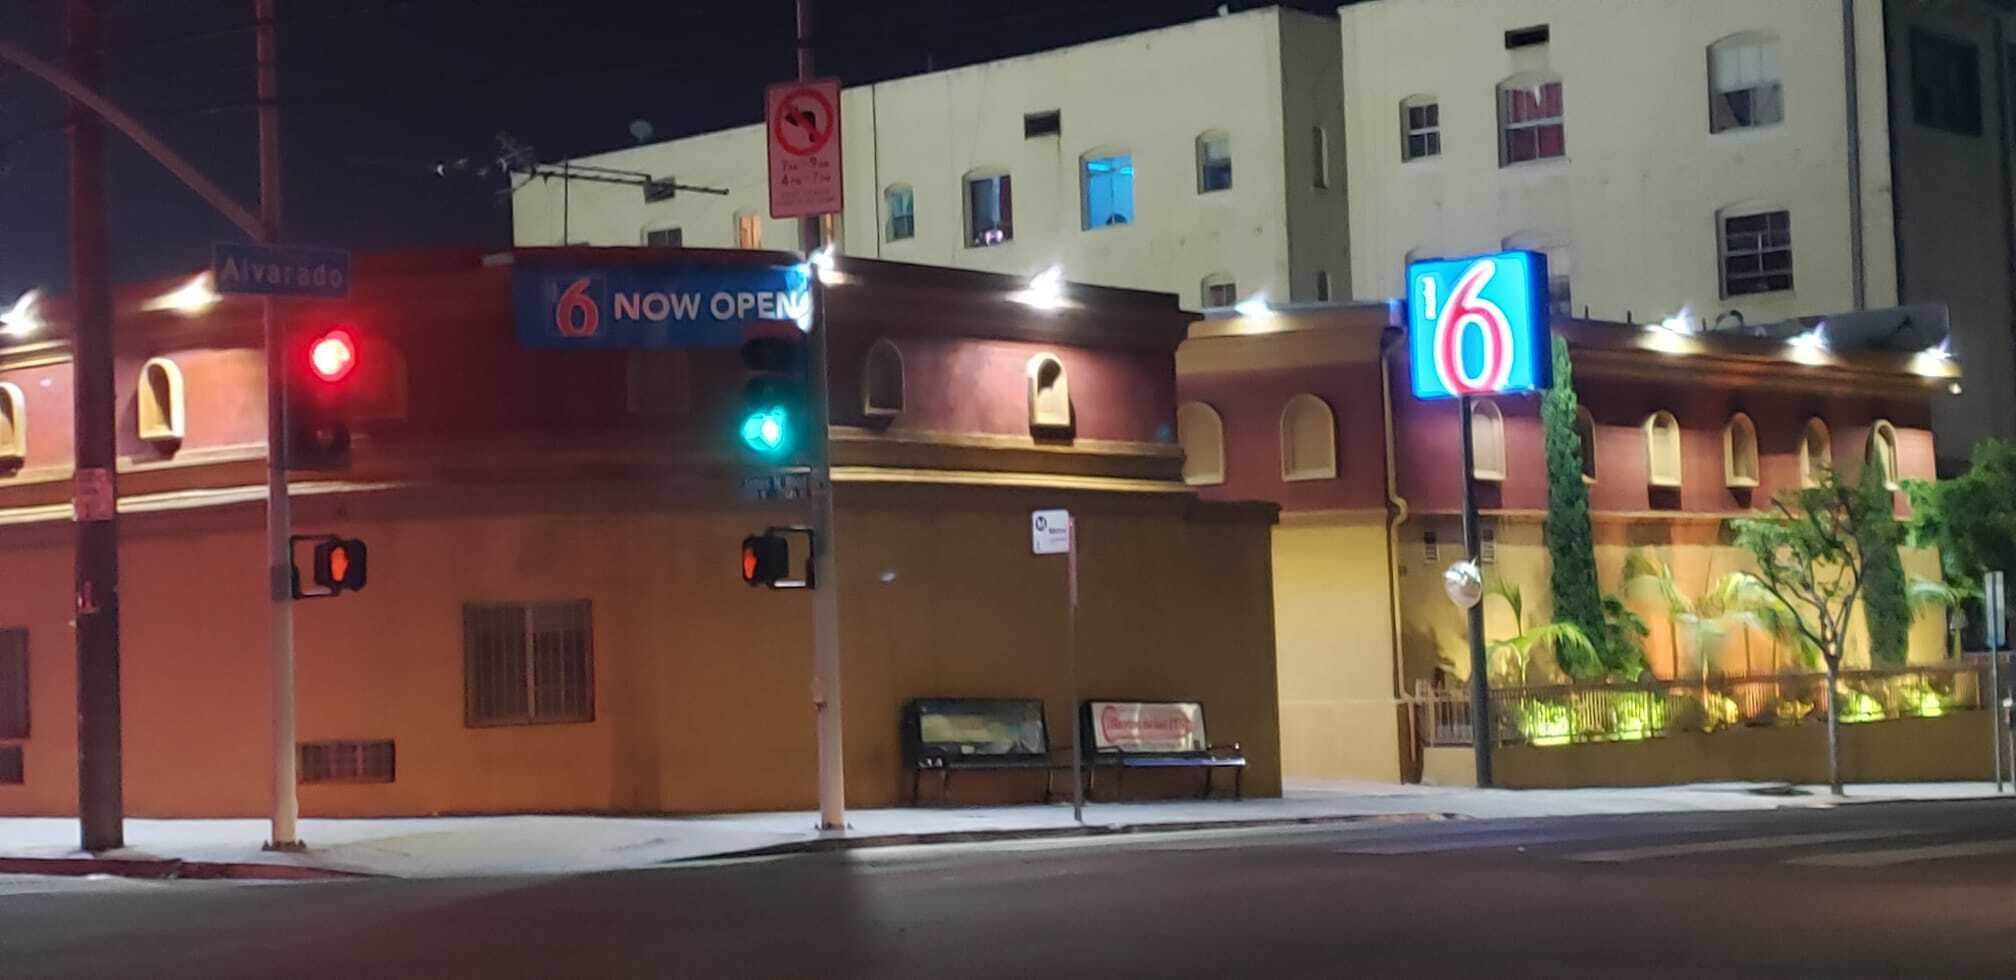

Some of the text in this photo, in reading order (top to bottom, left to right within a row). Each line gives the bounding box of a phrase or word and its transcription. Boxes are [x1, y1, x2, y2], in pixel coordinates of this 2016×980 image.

[221, 255, 344, 289] Alvarado
[555, 276, 600, 338] 6
[612, 291, 803, 321] NOW OPEN
